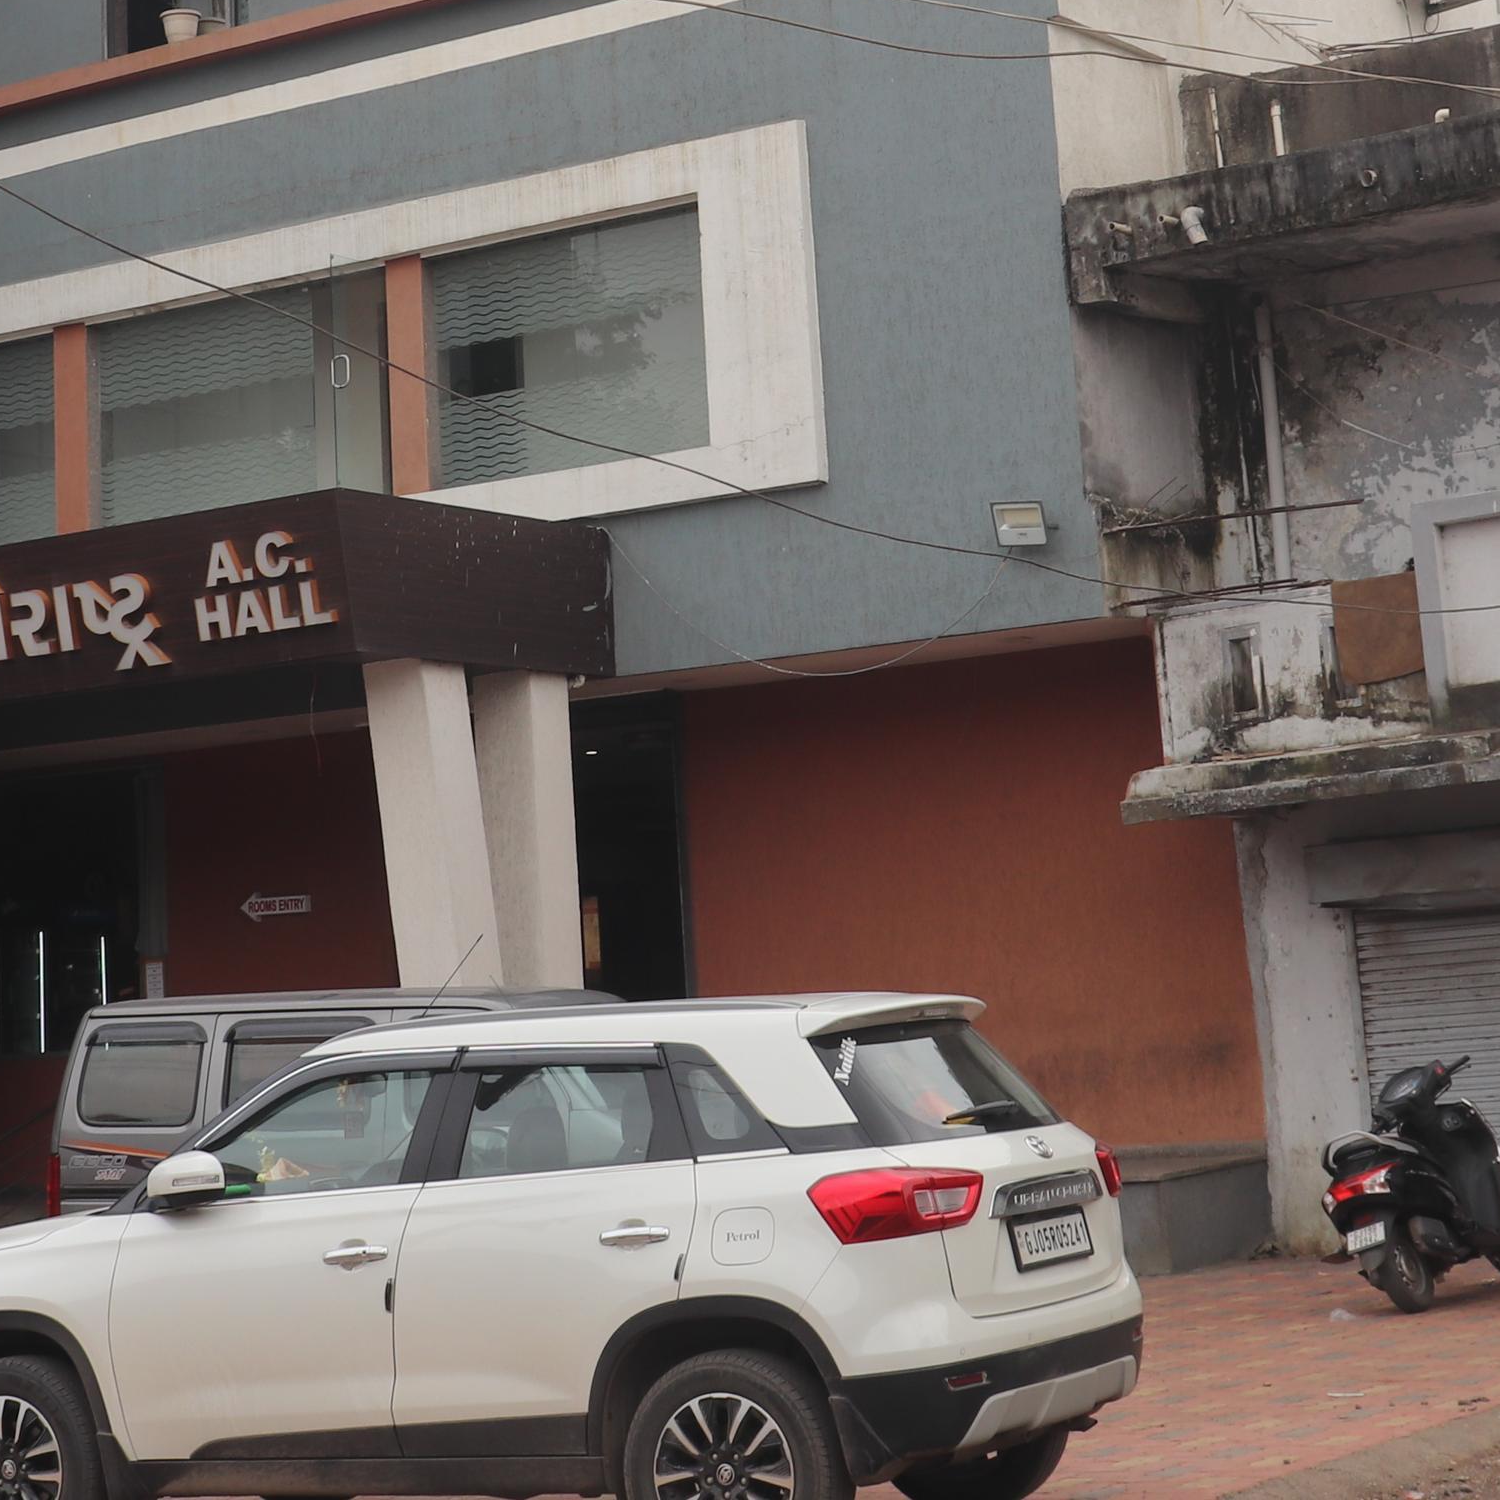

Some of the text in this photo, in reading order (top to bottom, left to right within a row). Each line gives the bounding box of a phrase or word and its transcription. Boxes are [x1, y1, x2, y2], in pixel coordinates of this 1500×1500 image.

[204, 531, 312, 589] A.C.
[195, 580, 339, 643] HALL
[248, 898, 306, 913] ROOMS ENTRY
[833, 1036, 857, 1086] Naitik
[726, 1229, 760, 1243] Petrol
